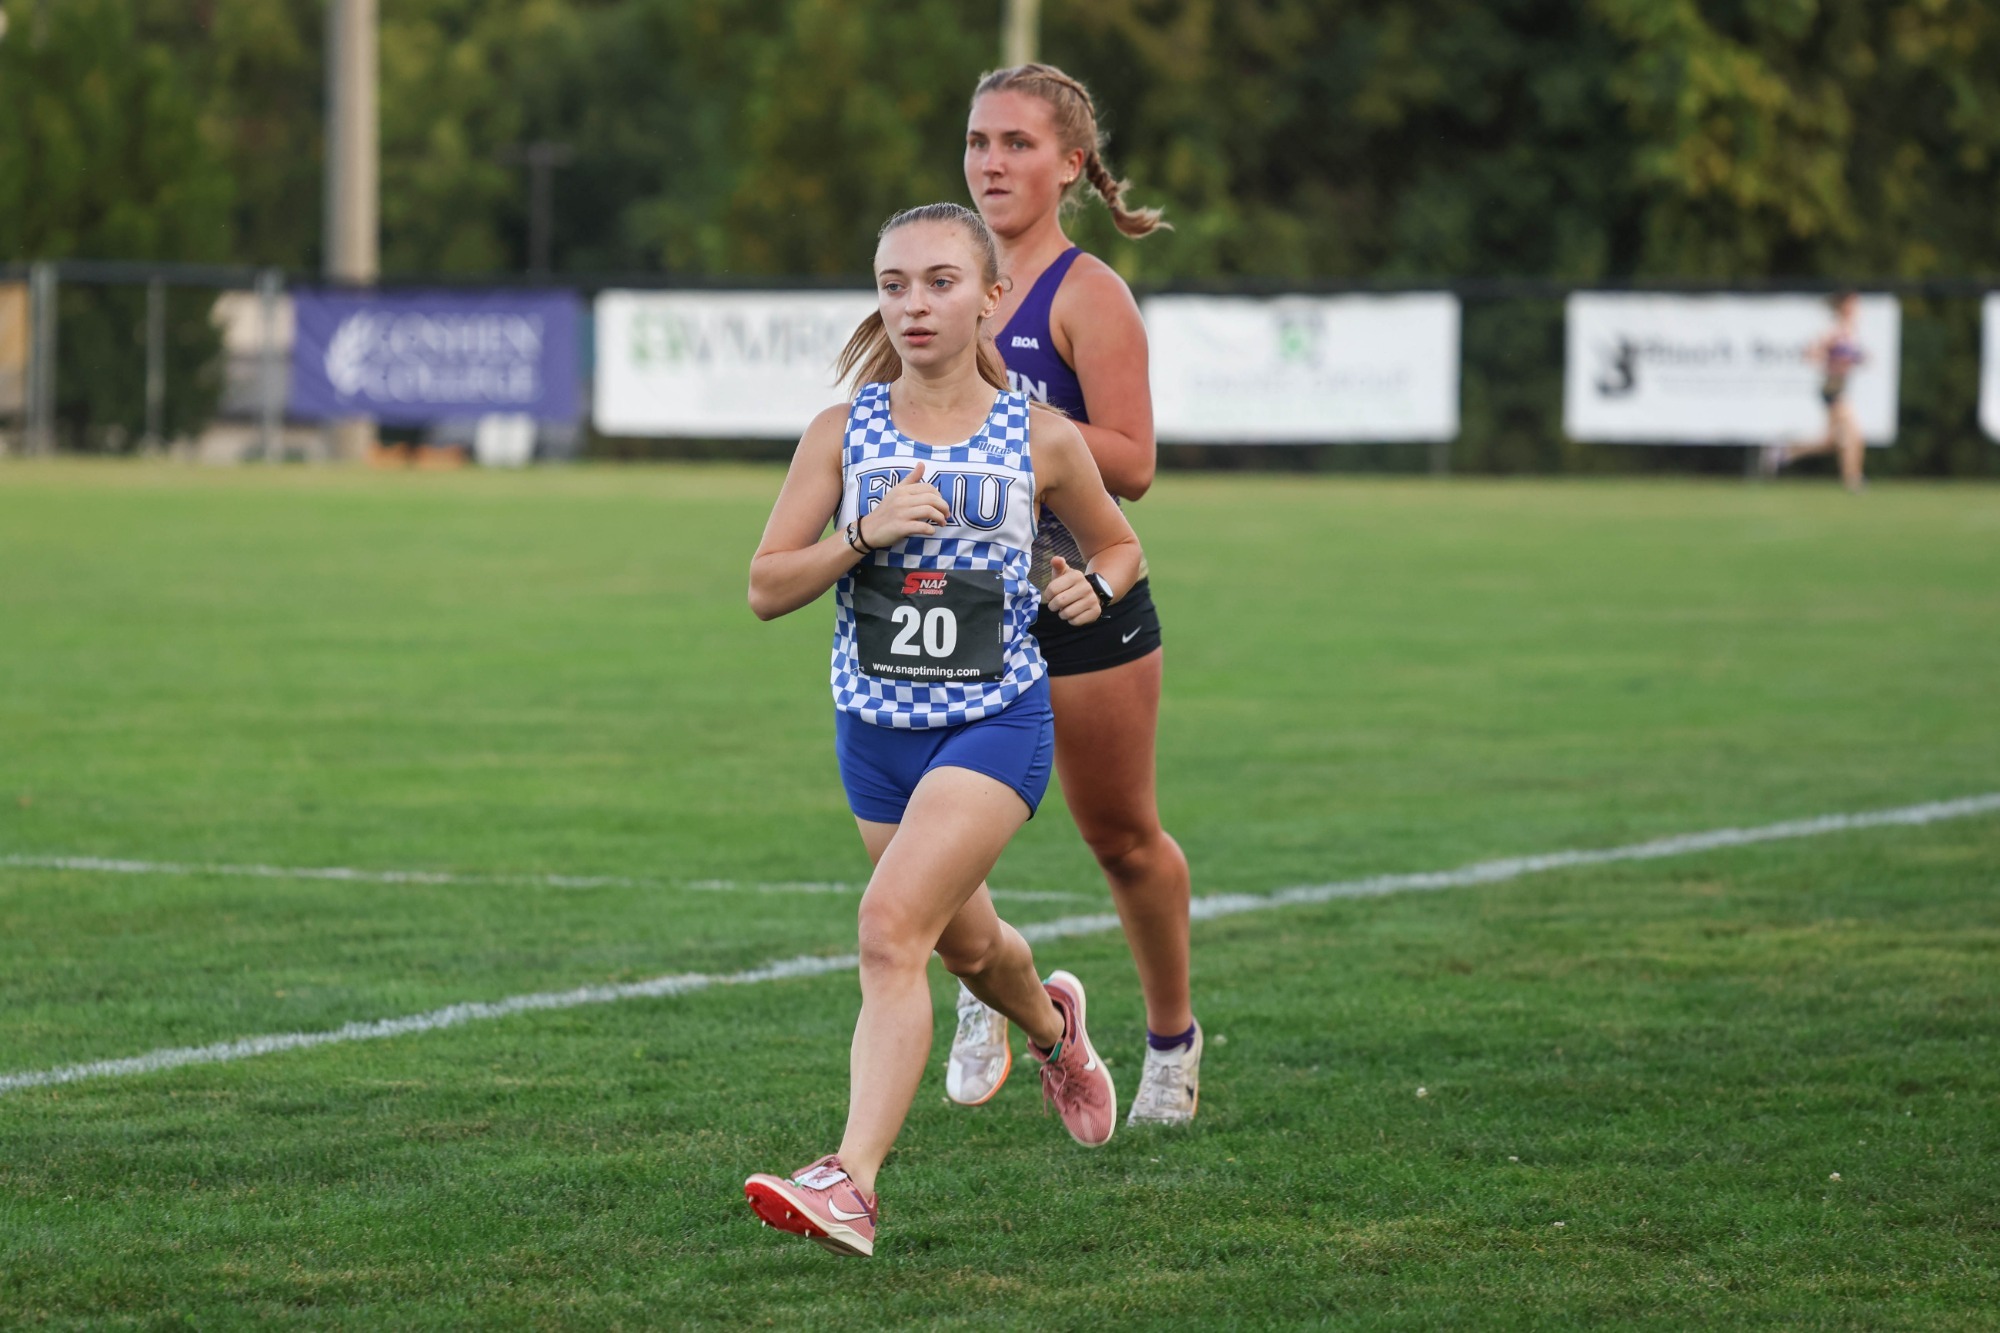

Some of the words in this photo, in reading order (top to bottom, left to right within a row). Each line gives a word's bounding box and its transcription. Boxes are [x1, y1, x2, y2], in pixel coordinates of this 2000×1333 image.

[1011, 336, 1039, 349] BOA
[901, 571, 947, 595] SNAP
[890, 605, 957, 658] 20
[872, 662, 980, 678] www.snaptiming.com
